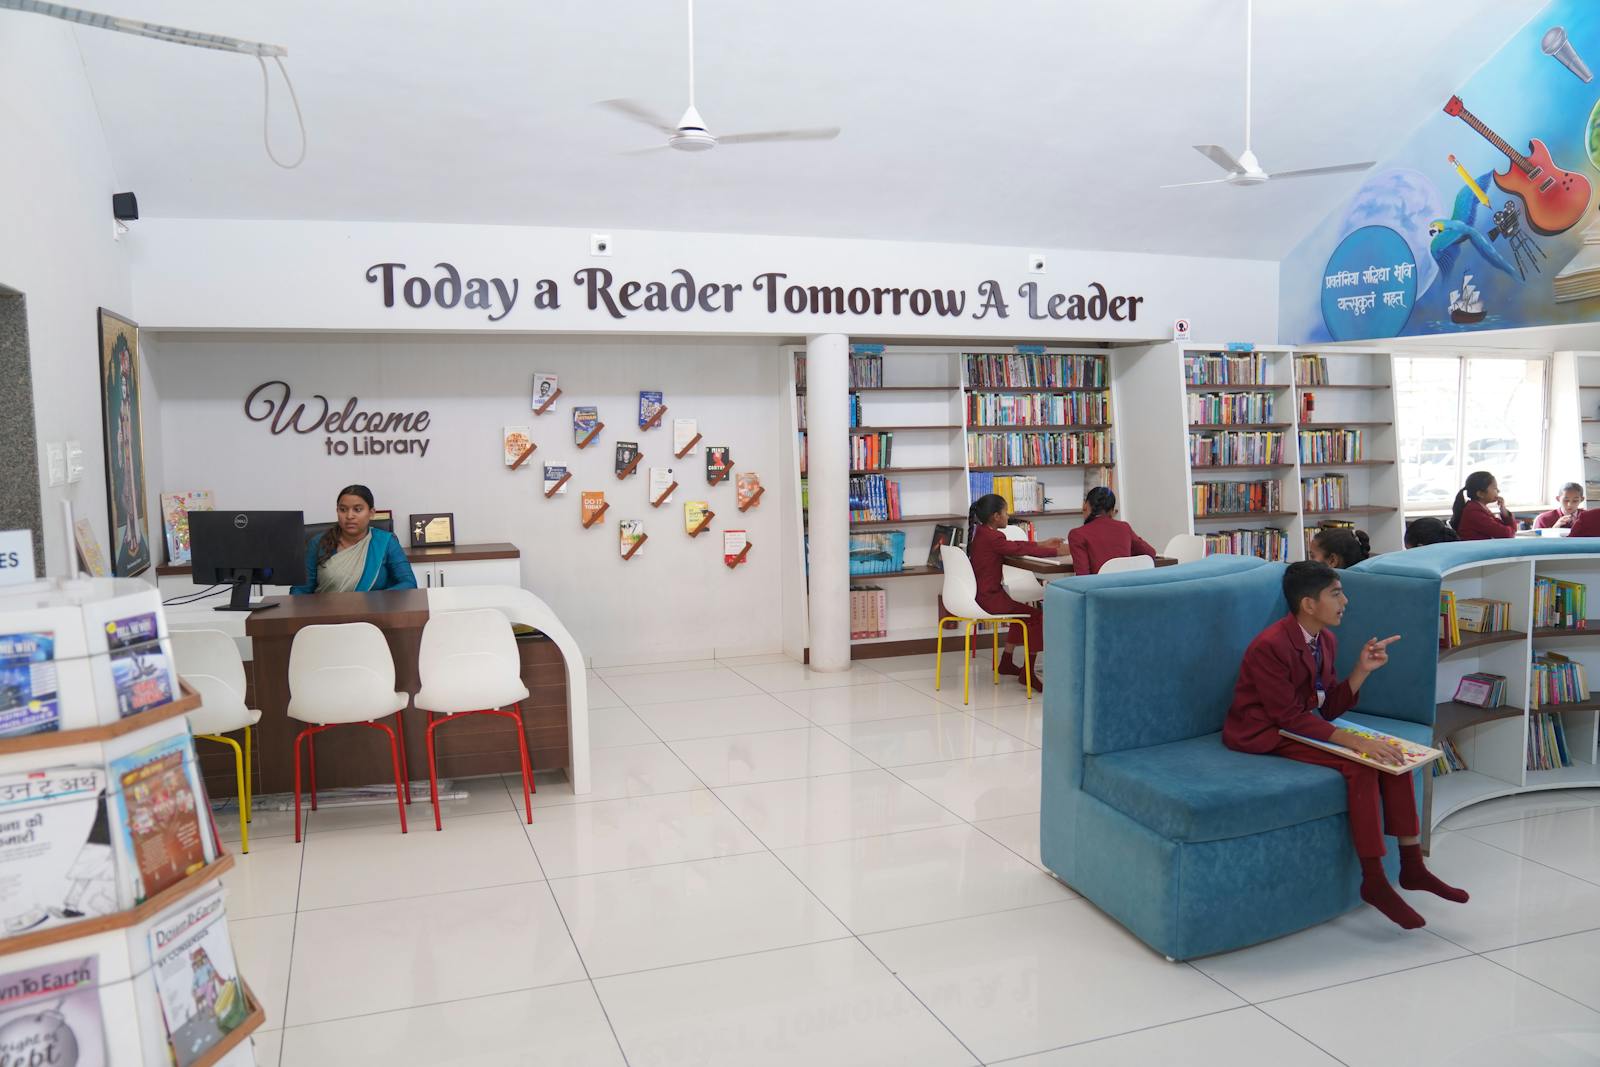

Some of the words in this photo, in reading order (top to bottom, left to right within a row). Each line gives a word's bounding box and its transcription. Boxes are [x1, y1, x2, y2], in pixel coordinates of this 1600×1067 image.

[365, 262, 519, 321] Today
[534, 278, 561, 310] a
[573, 267, 743, 319] Reader
[753, 271, 966, 317] Tomorrow
[972, 279, 1010, 320] A
[1018, 281, 1144, 322] Leader
[244, 380, 431, 436] Welcome
[325, 436, 349, 456] to
[353, 436, 430, 458] Library
